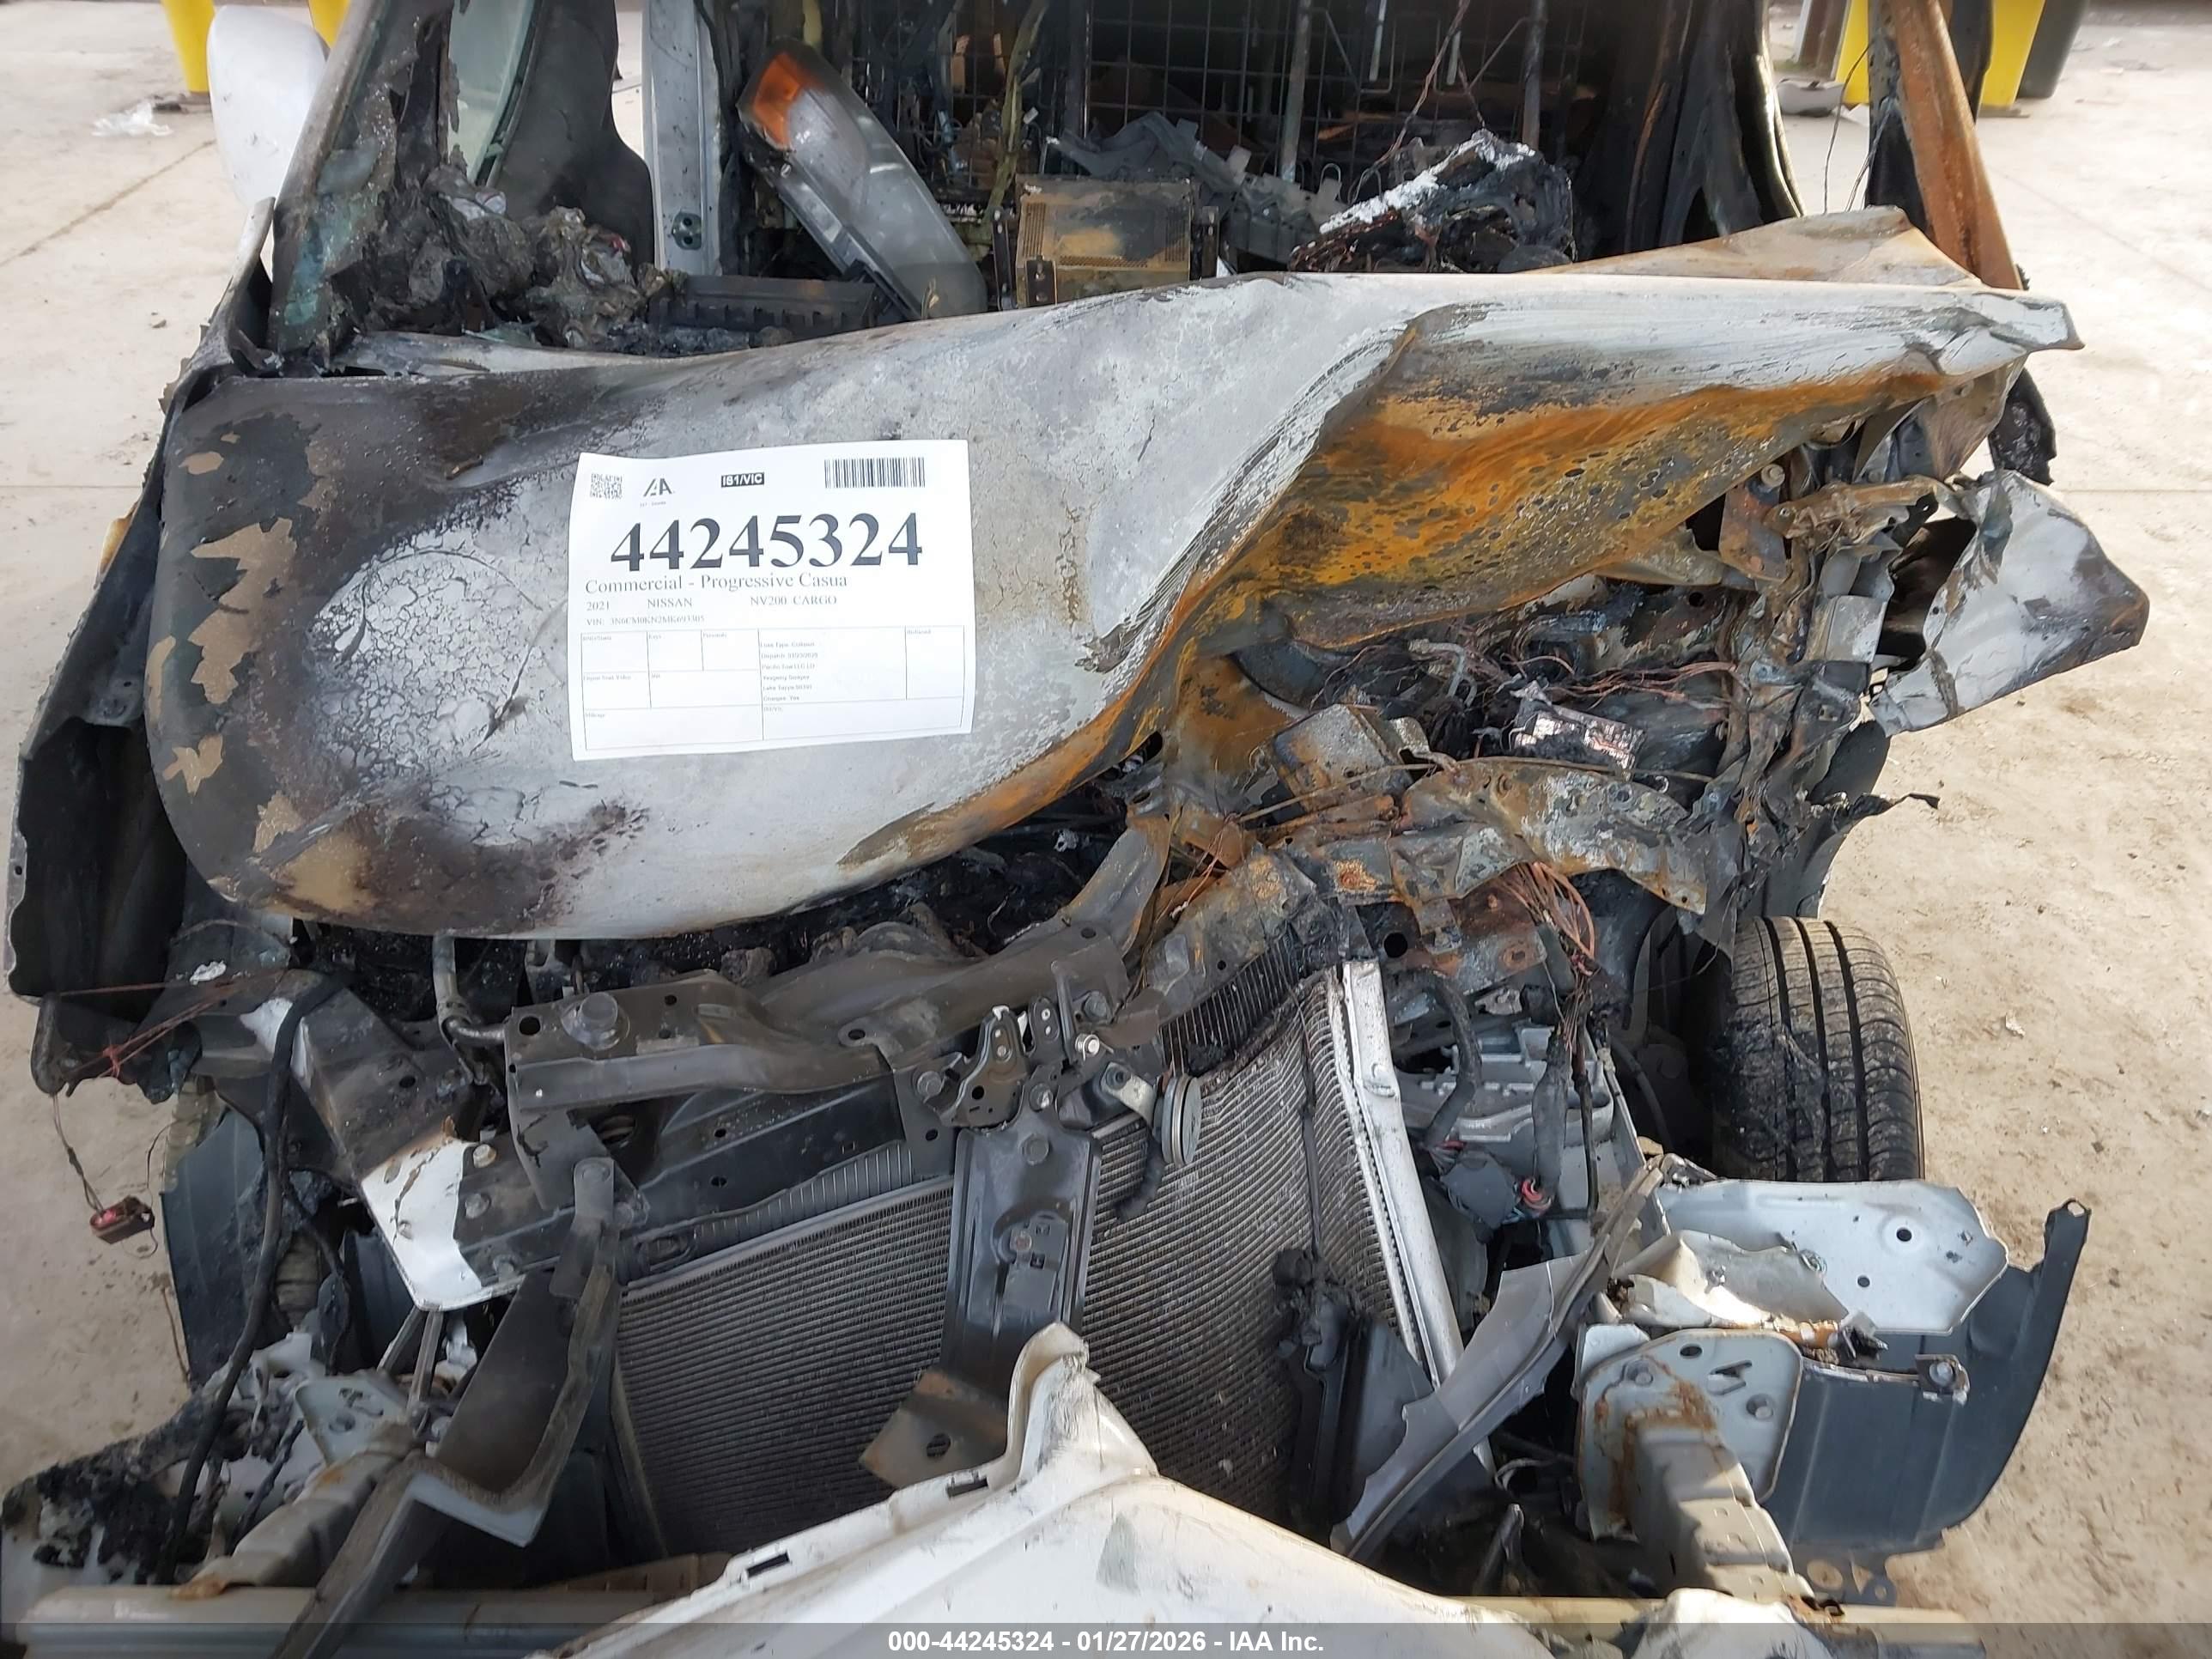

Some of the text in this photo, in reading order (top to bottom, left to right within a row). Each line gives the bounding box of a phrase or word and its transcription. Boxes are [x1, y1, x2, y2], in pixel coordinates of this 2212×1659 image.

[611, 512, 923, 573] 44245324
[585, 575, 684, 594] Commercial
[701, 573, 794, 591] Progressive
[799, 571, 848, 587] Casua
[586, 600, 611, 611] 2021
[647, 597, 693, 609] NISSAN
[750, 595, 838, 606] NV200 CARGO
